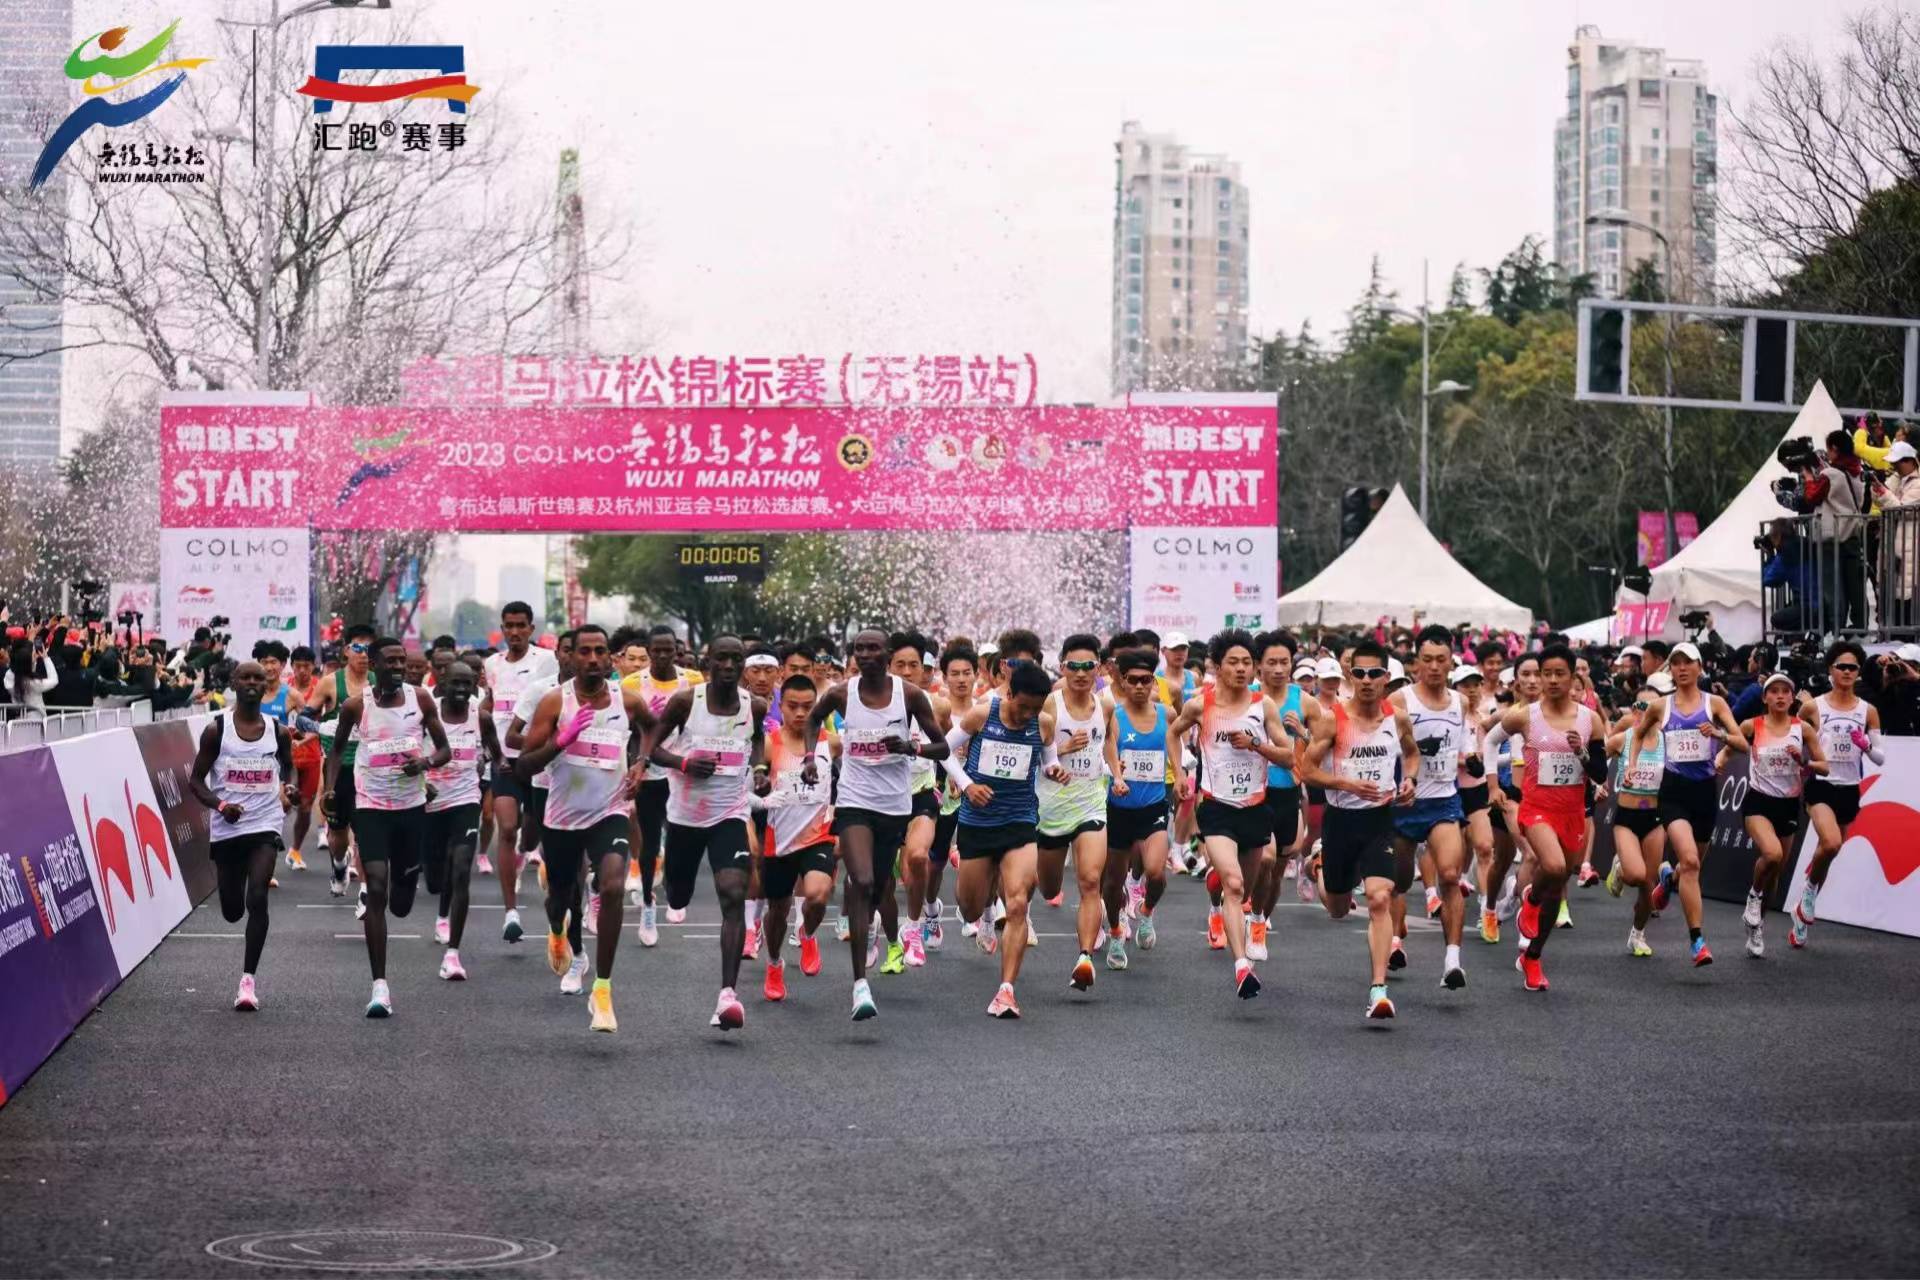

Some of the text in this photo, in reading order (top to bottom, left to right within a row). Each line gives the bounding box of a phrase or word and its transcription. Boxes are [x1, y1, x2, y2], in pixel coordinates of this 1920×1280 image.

[208, 425, 300, 451] BEST
[1175, 425, 1264, 451] BEST
[440, 442, 505, 466] 2023
[513, 444, 614, 464] COLMO
[625, 470, 821, 489] WUXI MARATHON
[174, 468, 299, 508] START
[1143, 469, 1264, 507] START
[186, 538, 289, 557] COLMO
[1153, 537, 1254, 556] COLMO
[680, 546, 760, 565] 00:00:06
[590, 743, 599, 755] 5
[850, 741, 887, 754] PACE
[1349, 745, 1388, 759] YUNNAN
[1678, 741, 1699, 752] 316
[1833, 743, 1852, 753] 109
[390, 752, 399, 764] 2
[995, 755, 1017, 767] 150
[1071, 758, 1091, 769] 119
[1132, 761, 1154, 772] 180
[1426, 761, 1445, 771] 111
[1553, 763, 1574, 775] 126
[228, 769, 273, 782] PACE 4
[1229, 773, 1252, 786] 164
[1357, 770, 1381, 781] 175
